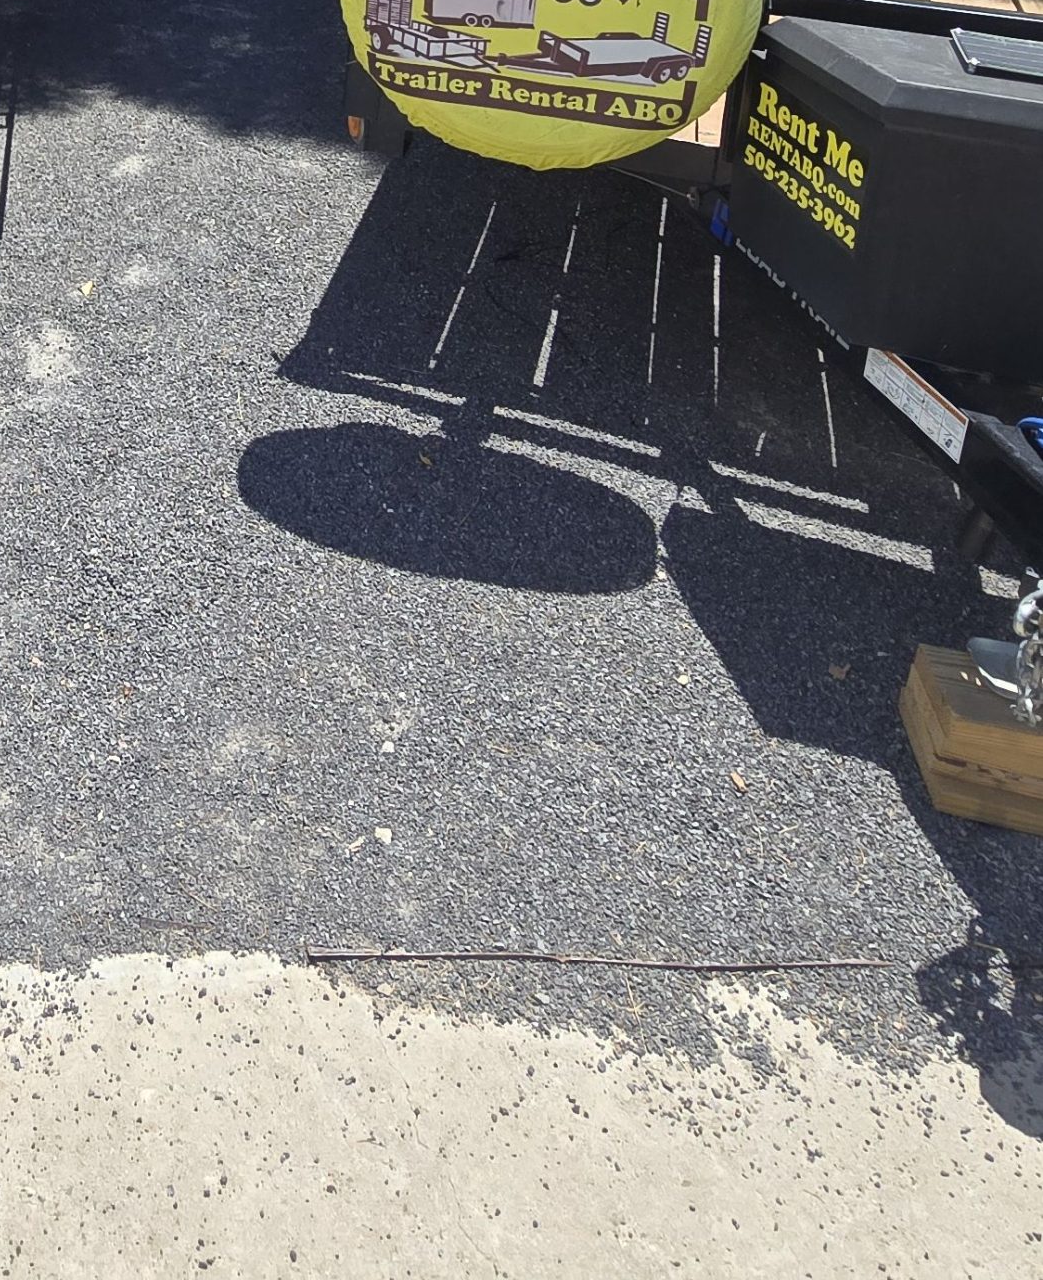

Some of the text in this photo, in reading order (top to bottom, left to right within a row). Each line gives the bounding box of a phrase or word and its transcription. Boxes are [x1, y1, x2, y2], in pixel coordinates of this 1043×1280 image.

[375, 61, 683, 125] Trailer Rental ABQ
[757, 82, 864, 187] Rent Me
[744, 144, 856, 249] 505-235-3962
[747, 116, 861, 220] RENTABQ.com
